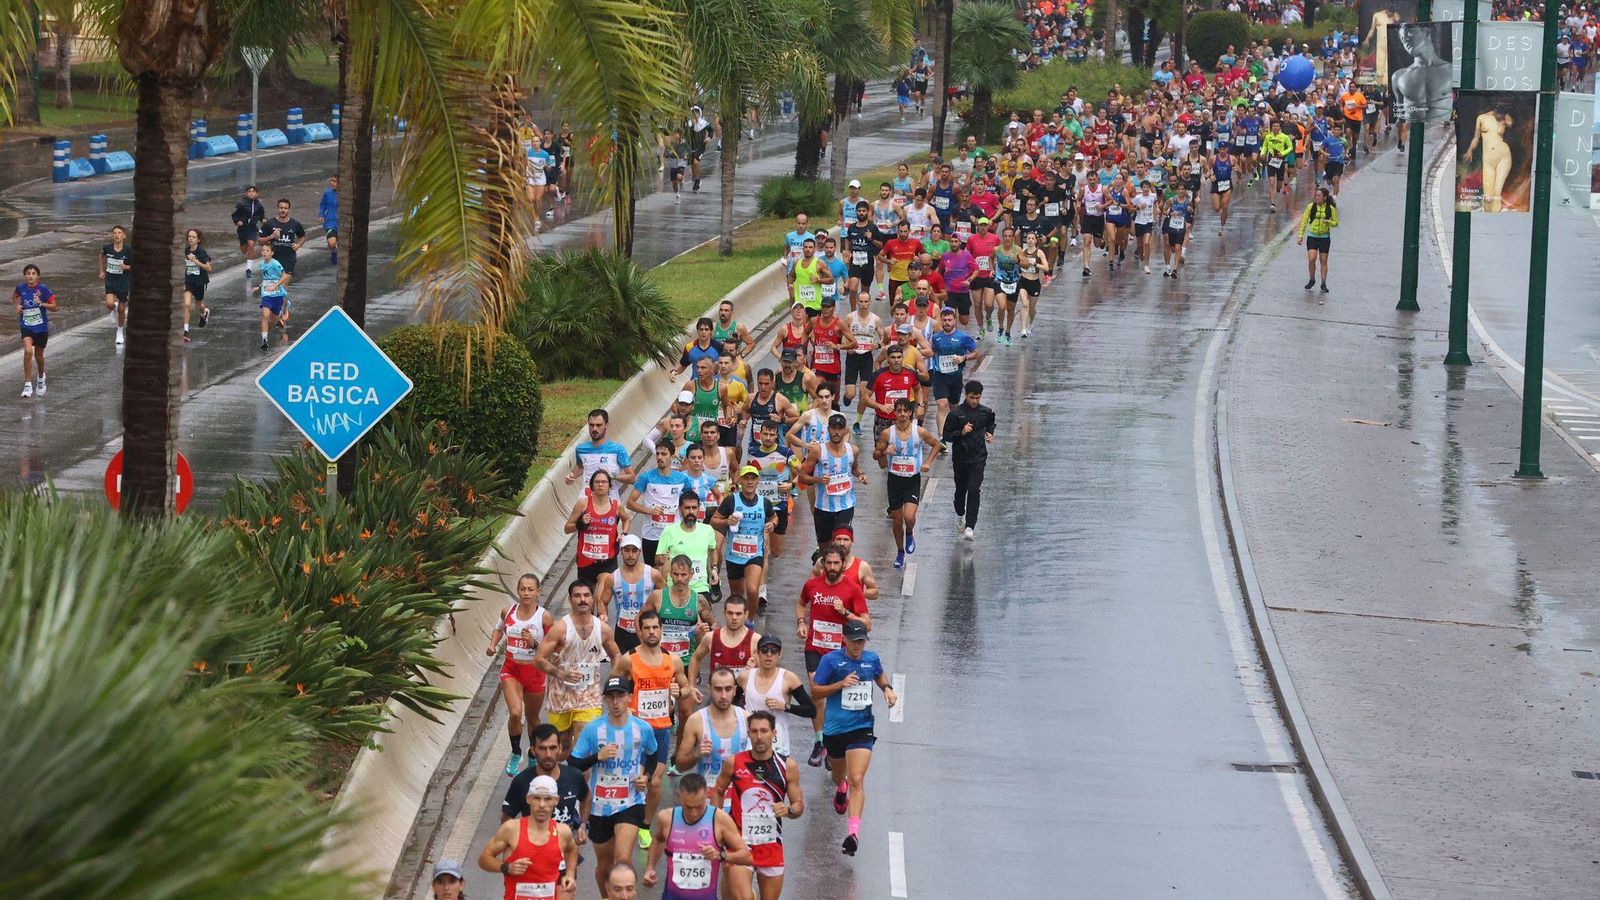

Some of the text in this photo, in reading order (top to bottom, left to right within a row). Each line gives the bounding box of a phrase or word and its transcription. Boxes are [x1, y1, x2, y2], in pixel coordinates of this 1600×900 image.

[1487, 35, 1533, 51] DES
[1494, 55, 1526, 70] NU
[1486, 75, 1533, 90] DOS
[309, 361, 360, 381] RED
[288, 384, 380, 405] BASICA
[658, 515, 669, 523] 33
[743, 510, 763, 521] erja
[589, 545, 603, 553] 202
[670, 643, 681, 652] 79
[847, 692, 868, 701] 7210
[641, 700, 667, 710] 12601
[604, 789, 618, 799] 27
[747, 825, 773, 835] 7252
[679, 867, 706, 878] 6756
